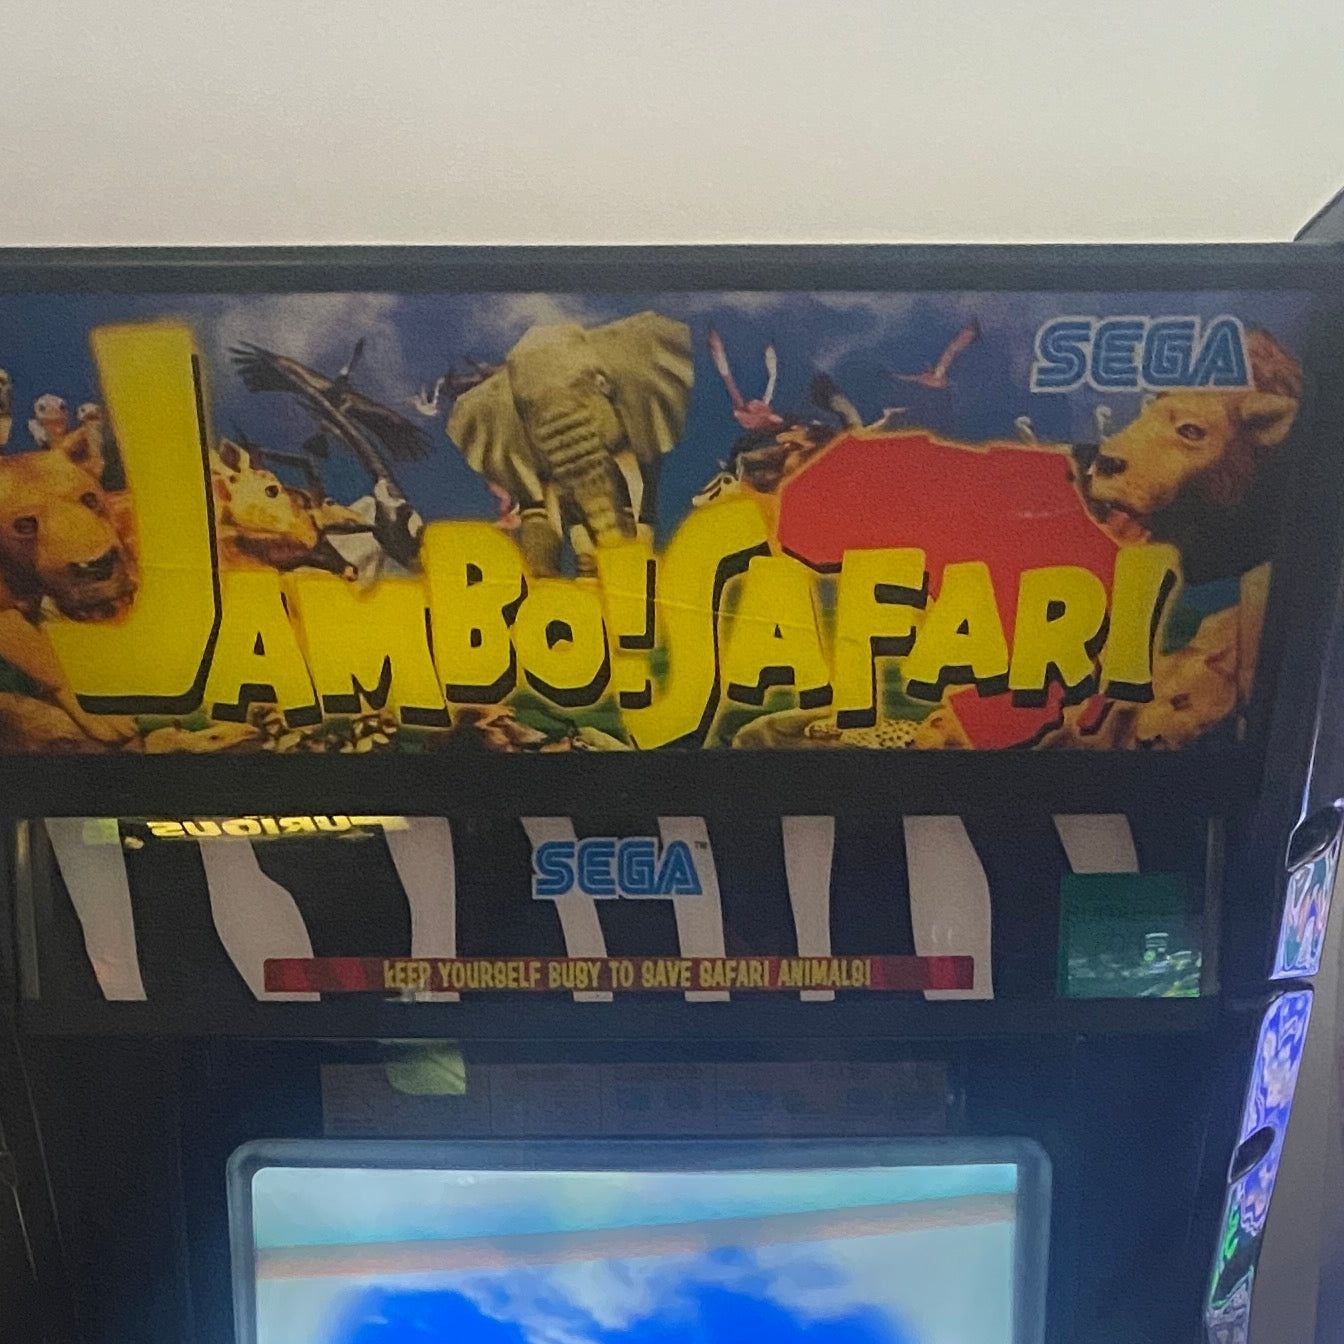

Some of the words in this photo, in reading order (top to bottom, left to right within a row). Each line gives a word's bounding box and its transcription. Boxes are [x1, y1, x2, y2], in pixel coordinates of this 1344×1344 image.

[1029, 314, 1255, 393] SEGA
[631, 490, 1181, 750] SAFARI
[532, 837, 703, 899] SEGA
[437, 961, 541, 988] YOURSELF
[548, 961, 602, 988] BUSY
[608, 961, 634, 987] TO
[641, 960, 692, 987] SAVE
[699, 960, 769, 987] SAFARI
